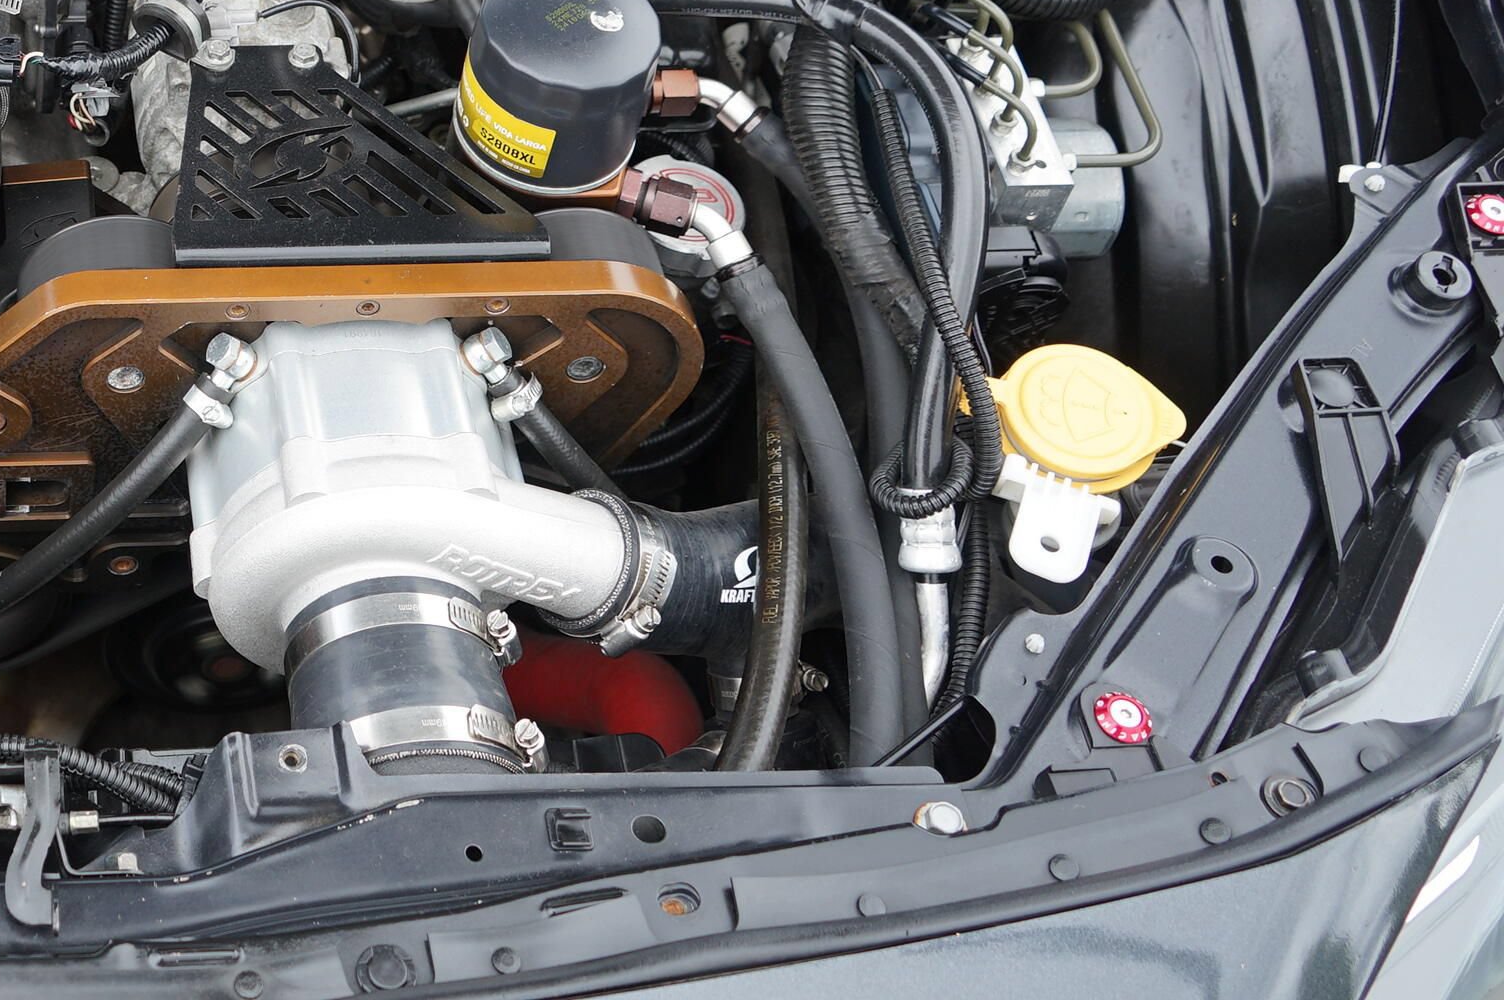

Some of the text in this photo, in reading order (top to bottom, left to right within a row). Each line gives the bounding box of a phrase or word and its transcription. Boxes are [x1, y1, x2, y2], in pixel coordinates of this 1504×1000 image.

[480, 127, 536, 165] S2808XL
[493, 121, 514, 139] VIDA
[515, 135, 547, 152] LARGA
[769, 515, 784, 531] 1/2
[762, 604, 778, 624] FUEL
